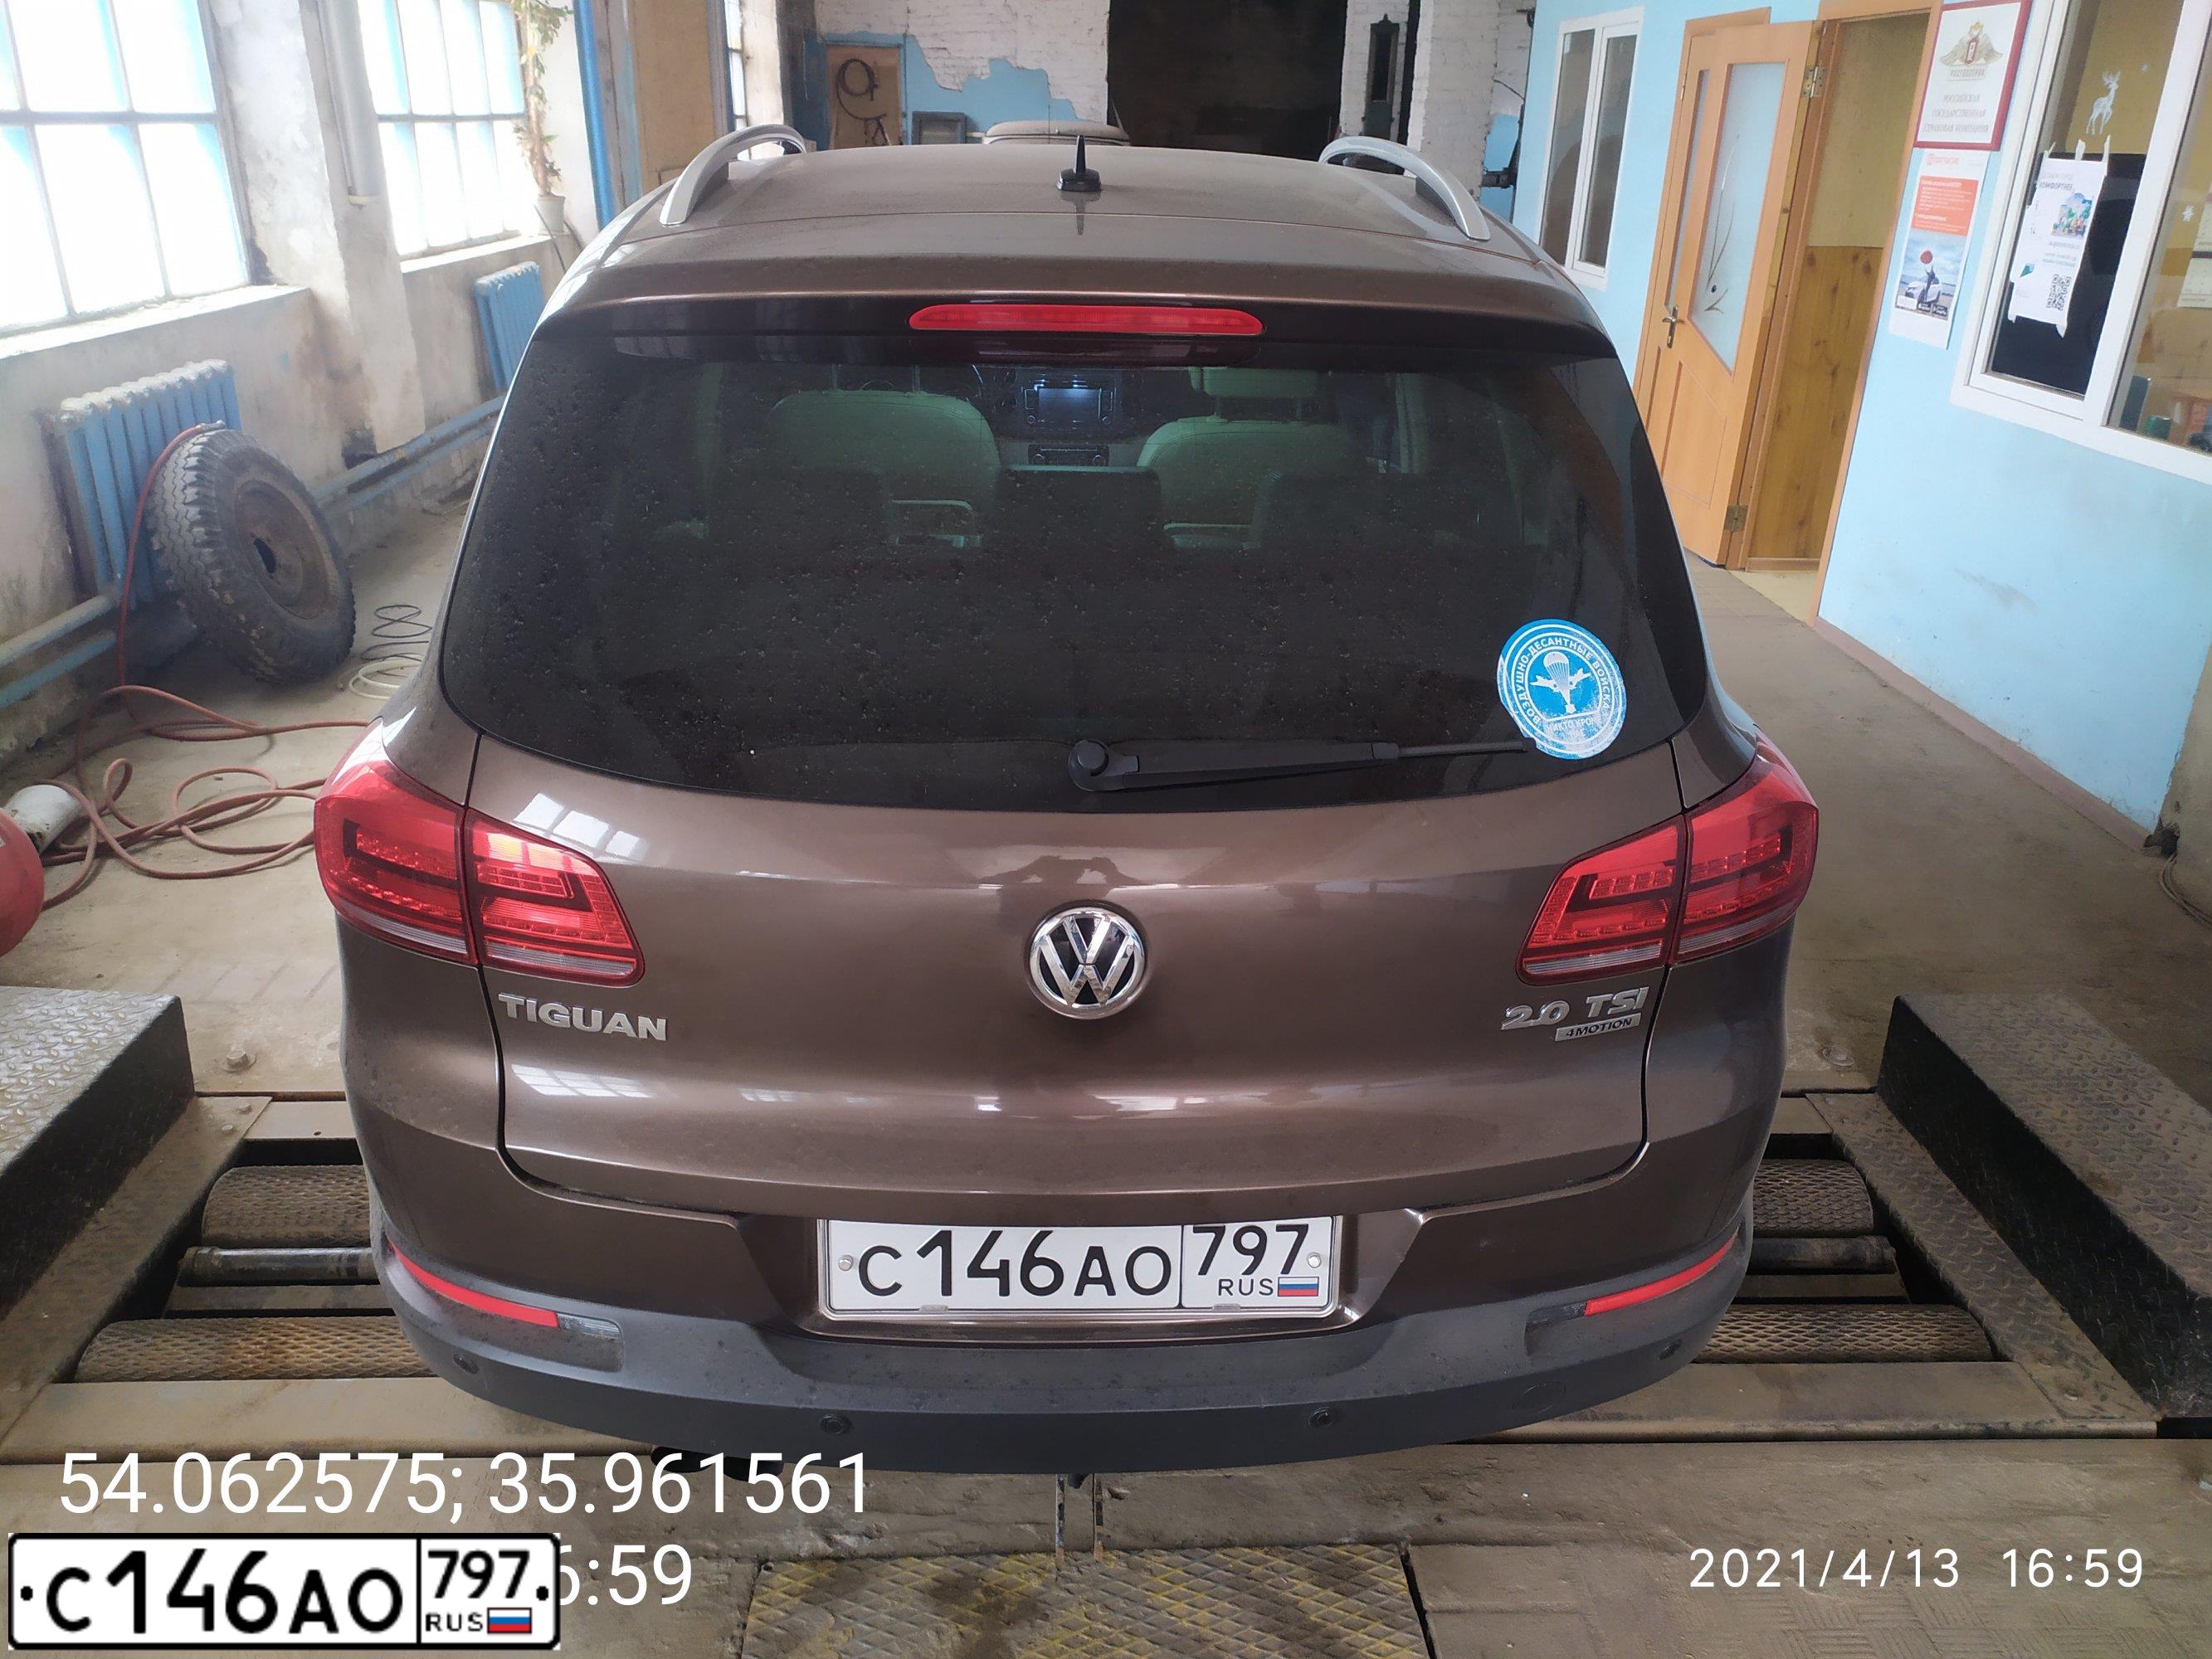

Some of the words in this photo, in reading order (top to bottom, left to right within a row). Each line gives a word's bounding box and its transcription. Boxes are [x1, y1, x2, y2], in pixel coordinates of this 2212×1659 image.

[498, 992, 667, 1041] TIGUAN
[1585, 986, 1649, 1018] TSI
[1566, 1017, 1633, 1037] 4MOTION
[1191, 1224, 1310, 1276] 797
[1218, 1278, 1274, 1297] RUS
